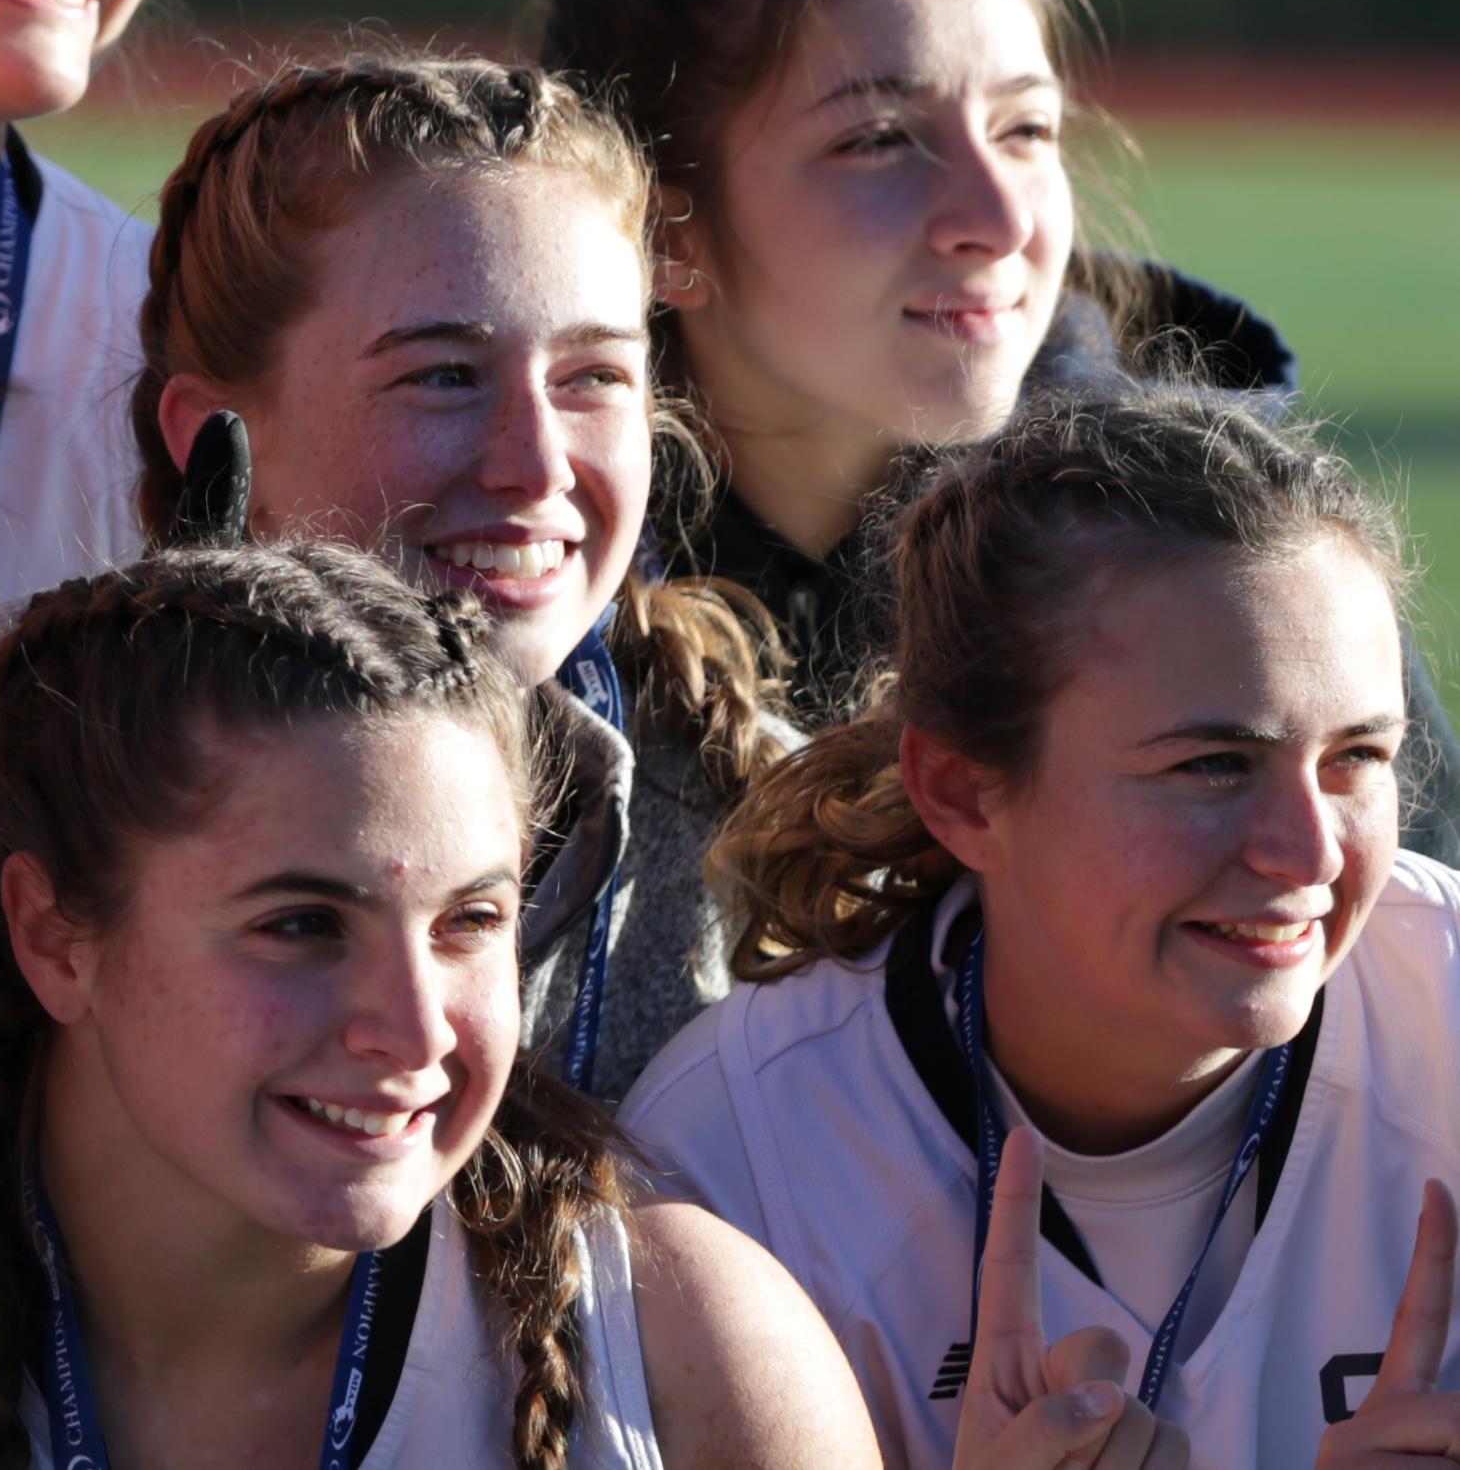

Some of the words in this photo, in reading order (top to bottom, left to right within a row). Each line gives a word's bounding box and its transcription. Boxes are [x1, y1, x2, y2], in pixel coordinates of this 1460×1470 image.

[352, 1251, 384, 1360] AMPION
[54, 1310, 84, 1447] CHAMPION
[345, 1372, 361, 1409] MIAA
